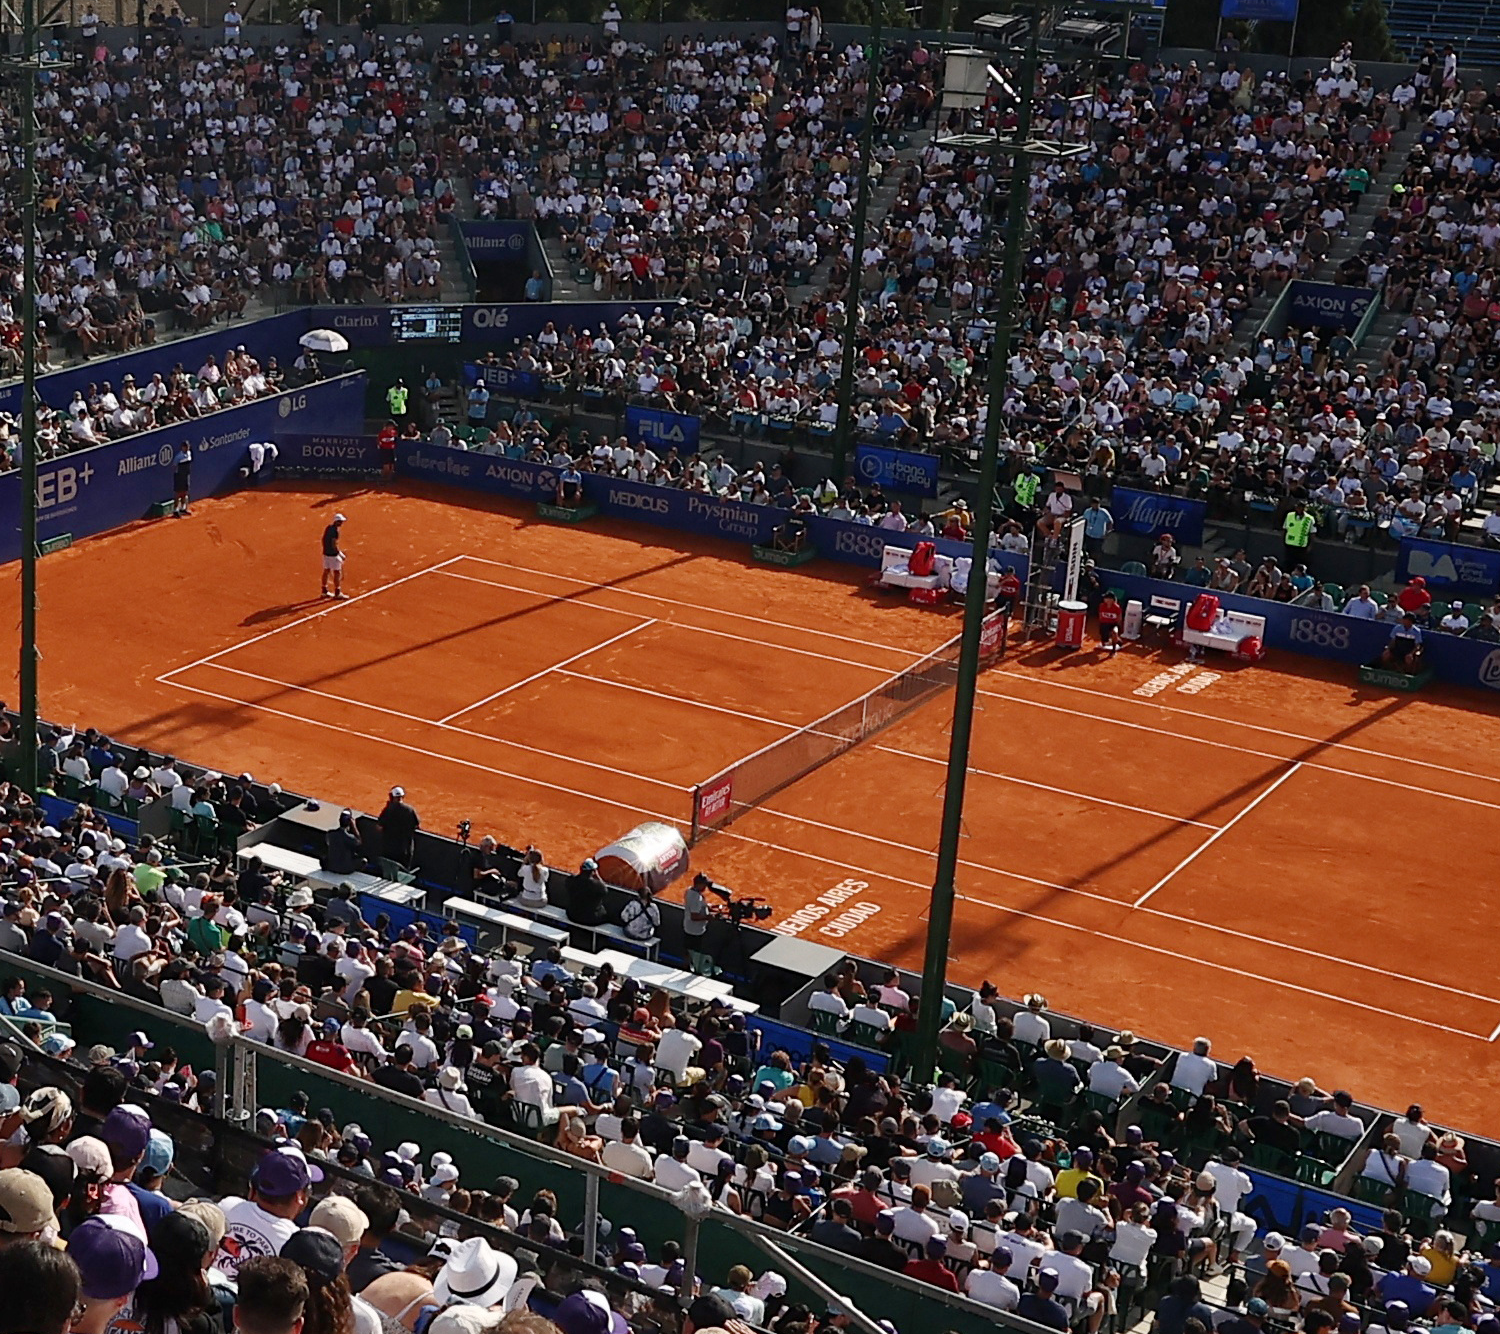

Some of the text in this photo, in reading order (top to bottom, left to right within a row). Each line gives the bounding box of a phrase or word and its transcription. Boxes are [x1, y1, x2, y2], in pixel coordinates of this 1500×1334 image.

[1294, 294, 1346, 312] AXION
[473, 307, 509, 328] Olé
[292, 395, 307, 411] LG
[209, 428, 251, 450] Santander
[312, 437, 361, 446] MARRIOTT
[637, 419, 685, 442] FILA
[302, 445, 367, 459] BONVOY
[117, 453, 157, 476] Allianz
[485, 464, 535, 486] AXION
[885, 459, 925, 476] urbana
[37, 461, 95, 509] EB+
[907, 474, 931, 488] play
[608, 489, 669, 514] MEDICUS
[687, 497, 759, 525] Prysmian
[1120, 495, 1186, 535] Magret
[719, 517, 759, 538] Group
[835, 531, 885, 558] 1888
[1407, 550, 1459, 583] BA
[1290, 618, 1351, 650] 1888
[701, 783, 731, 809] Emirates
[769, 877, 869, 937] UENOS AIRES
[819, 900, 882, 939] CIUDAD
[256, 1236, 274, 1258] PARA
